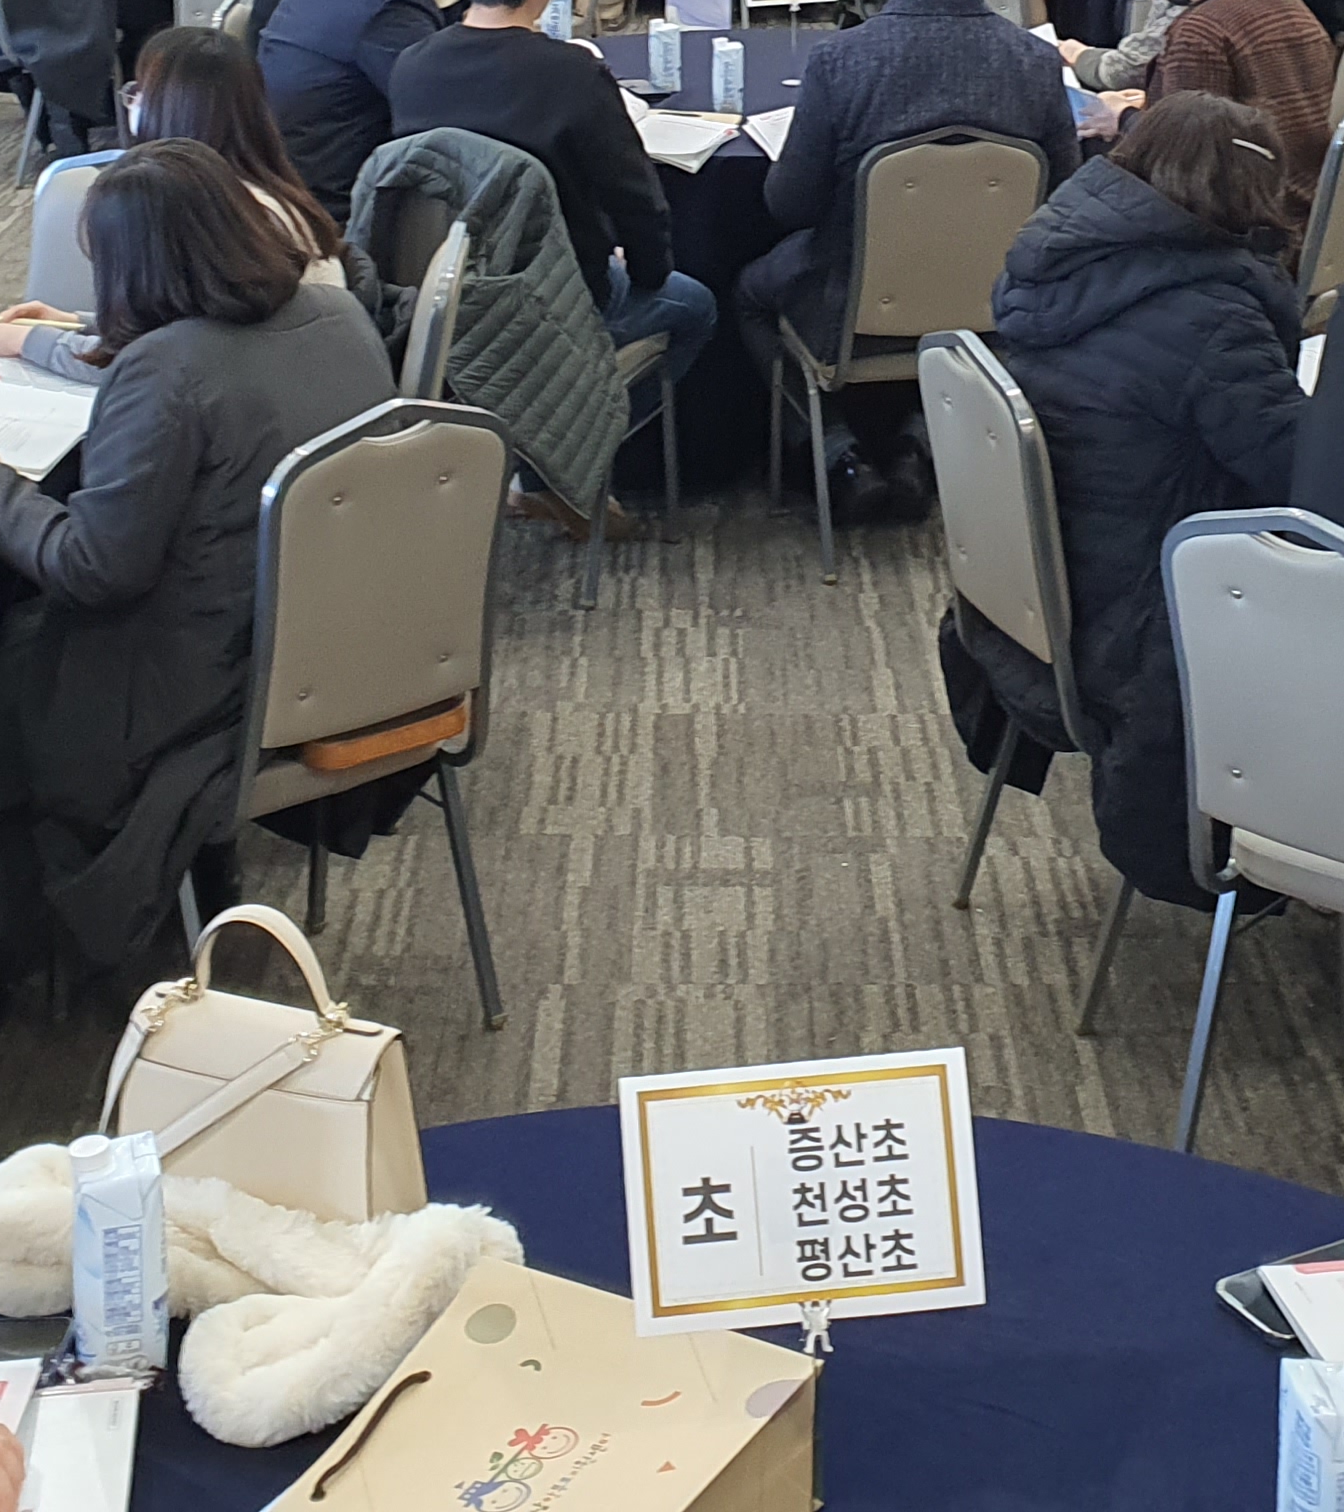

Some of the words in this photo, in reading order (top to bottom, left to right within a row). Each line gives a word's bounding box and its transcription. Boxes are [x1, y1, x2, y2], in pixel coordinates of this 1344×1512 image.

[786, 1117, 910, 1173] 증산초
[681, 1176, 739, 1246] 초
[791, 1173, 915, 1228] 천성초
[795, 1228, 919, 1283] 평산초
